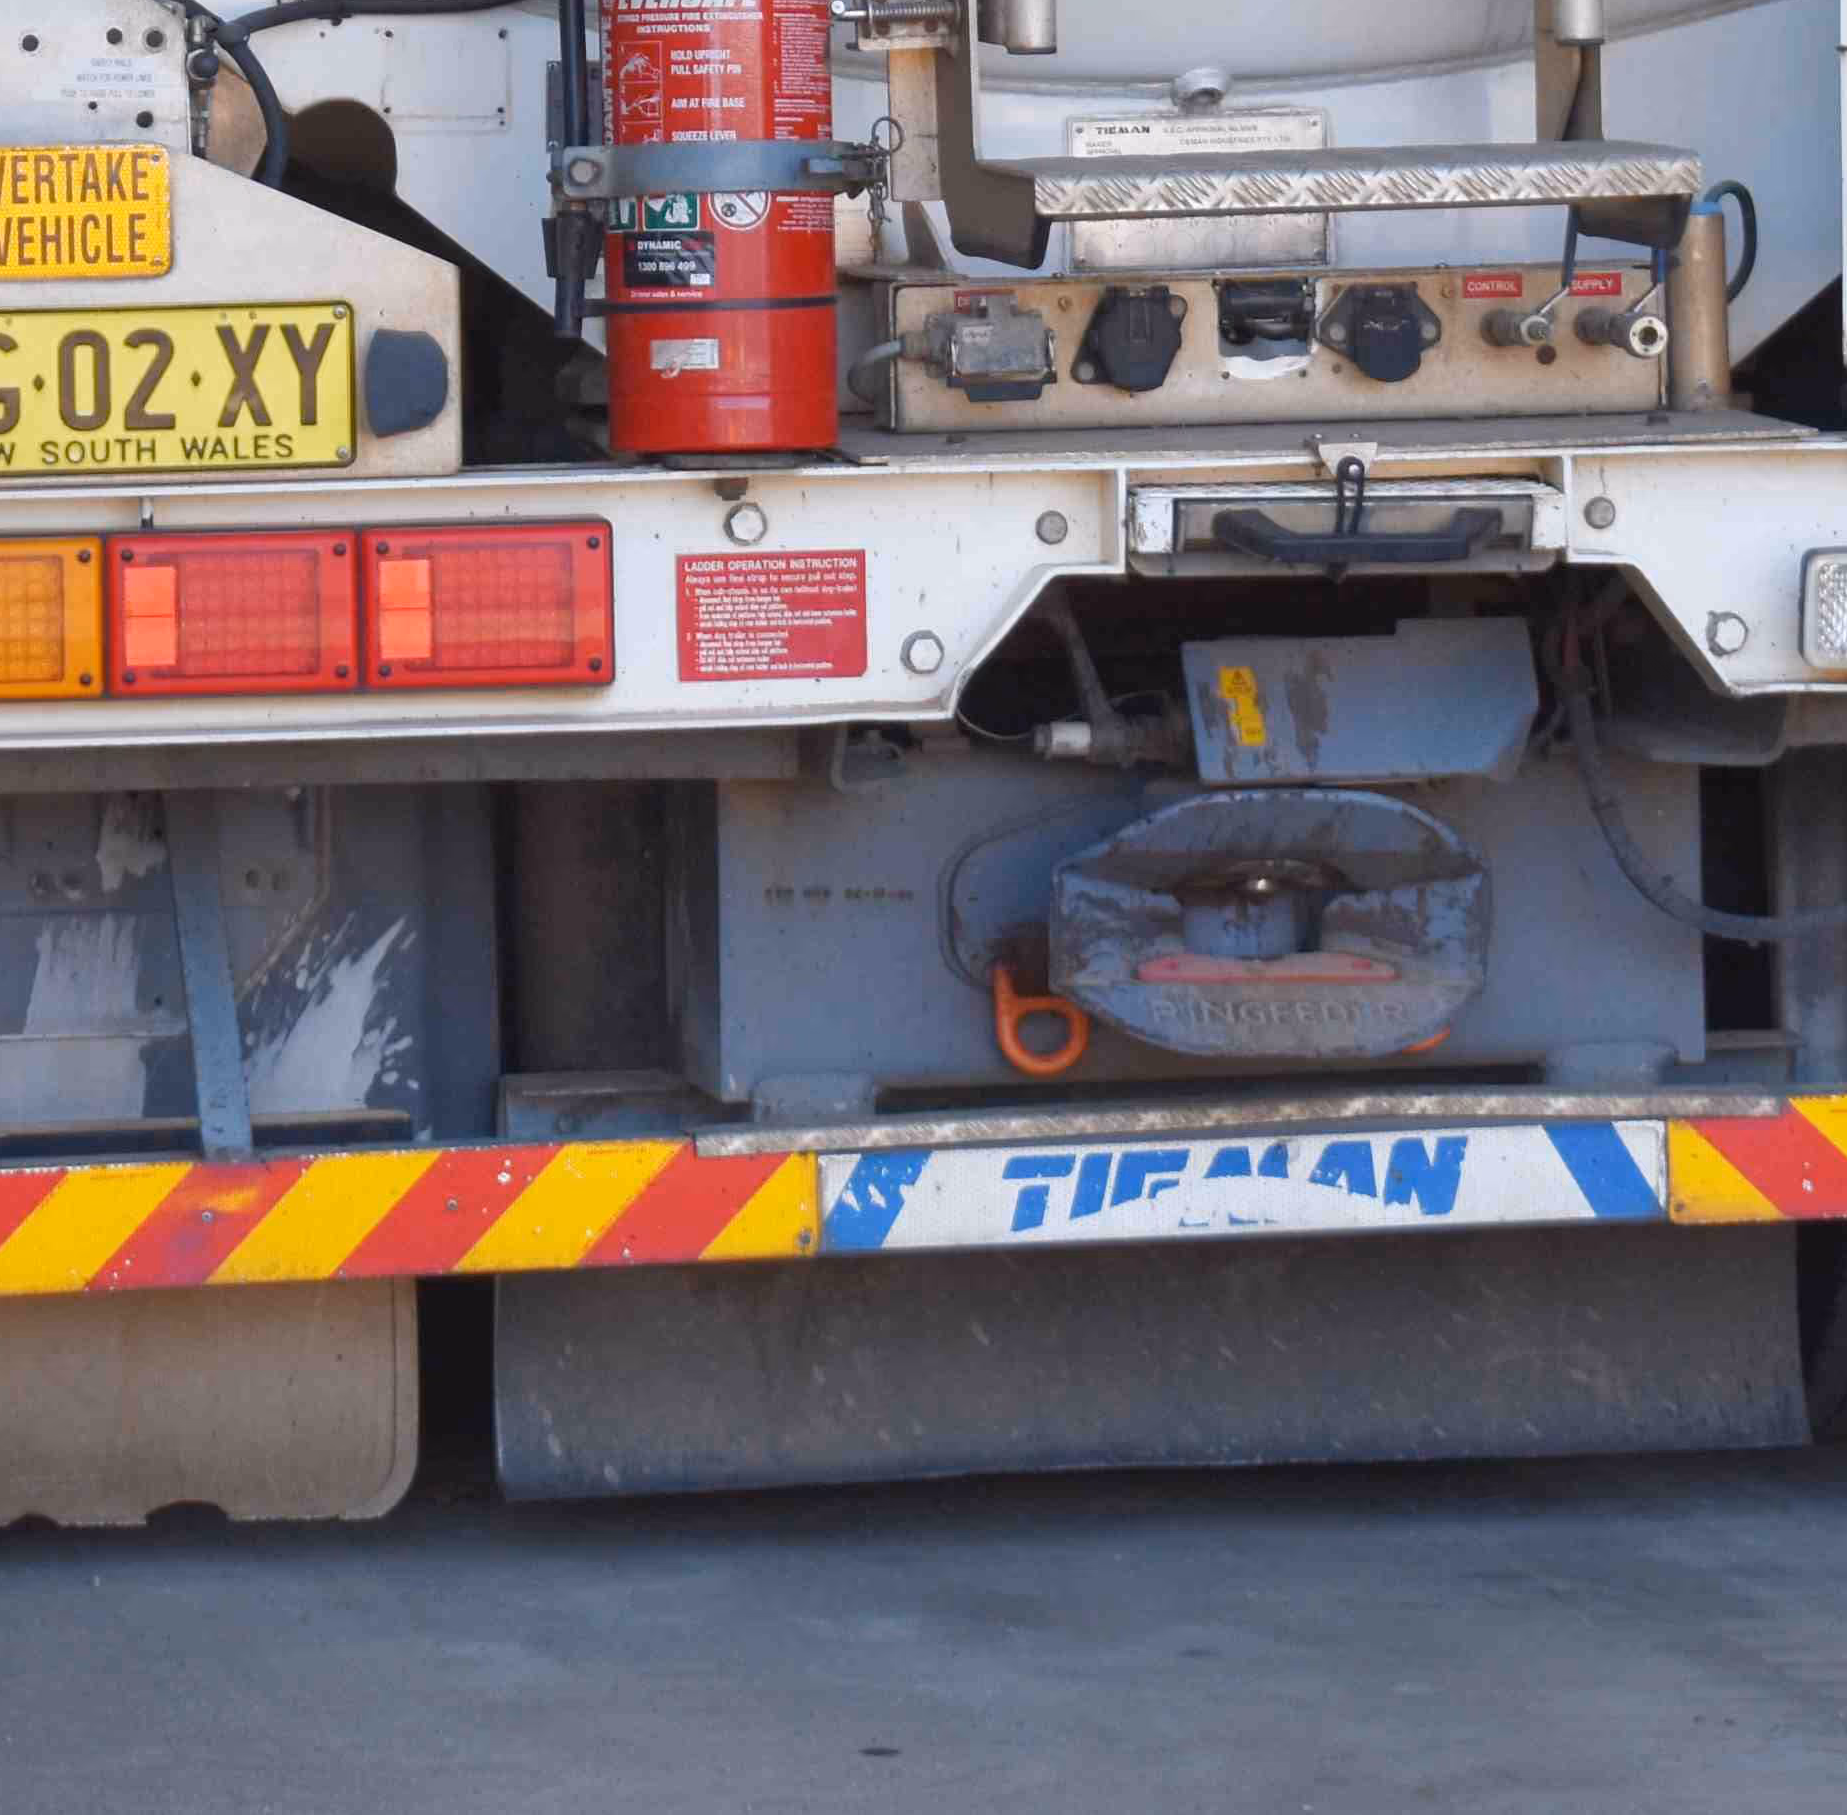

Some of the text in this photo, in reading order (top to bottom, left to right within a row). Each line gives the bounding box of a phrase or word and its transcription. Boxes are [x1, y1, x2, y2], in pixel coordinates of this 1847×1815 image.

[682, 13, 701, 21] FIRE
[637, 25, 711, 33] INSTRUCTIONS
[671, 50, 730, 59] HOLD UPRIGHT
[671, 65, 742, 75] PULL SAFETY PIN
[671, 98, 746, 107] AIM AT FIRE BASE
[602, 89, 613, 145] OAM
[1095, 126, 1150, 134] TIEMAN
[672, 131, 736, 141] SQUEEZE LEVER
[638, 241, 682, 250] DYNAMIC
[638, 262, 657, 271] 1300
[1467, 281, 1518, 292] CONTROL
[1571, 279, 1613, 290] SUPPLY
[42, 439, 155, 465] SOUTH
[182, 435, 293, 461] WALES
[685, 558, 857, 572] LADDER OPERATION INSTRUCTION
